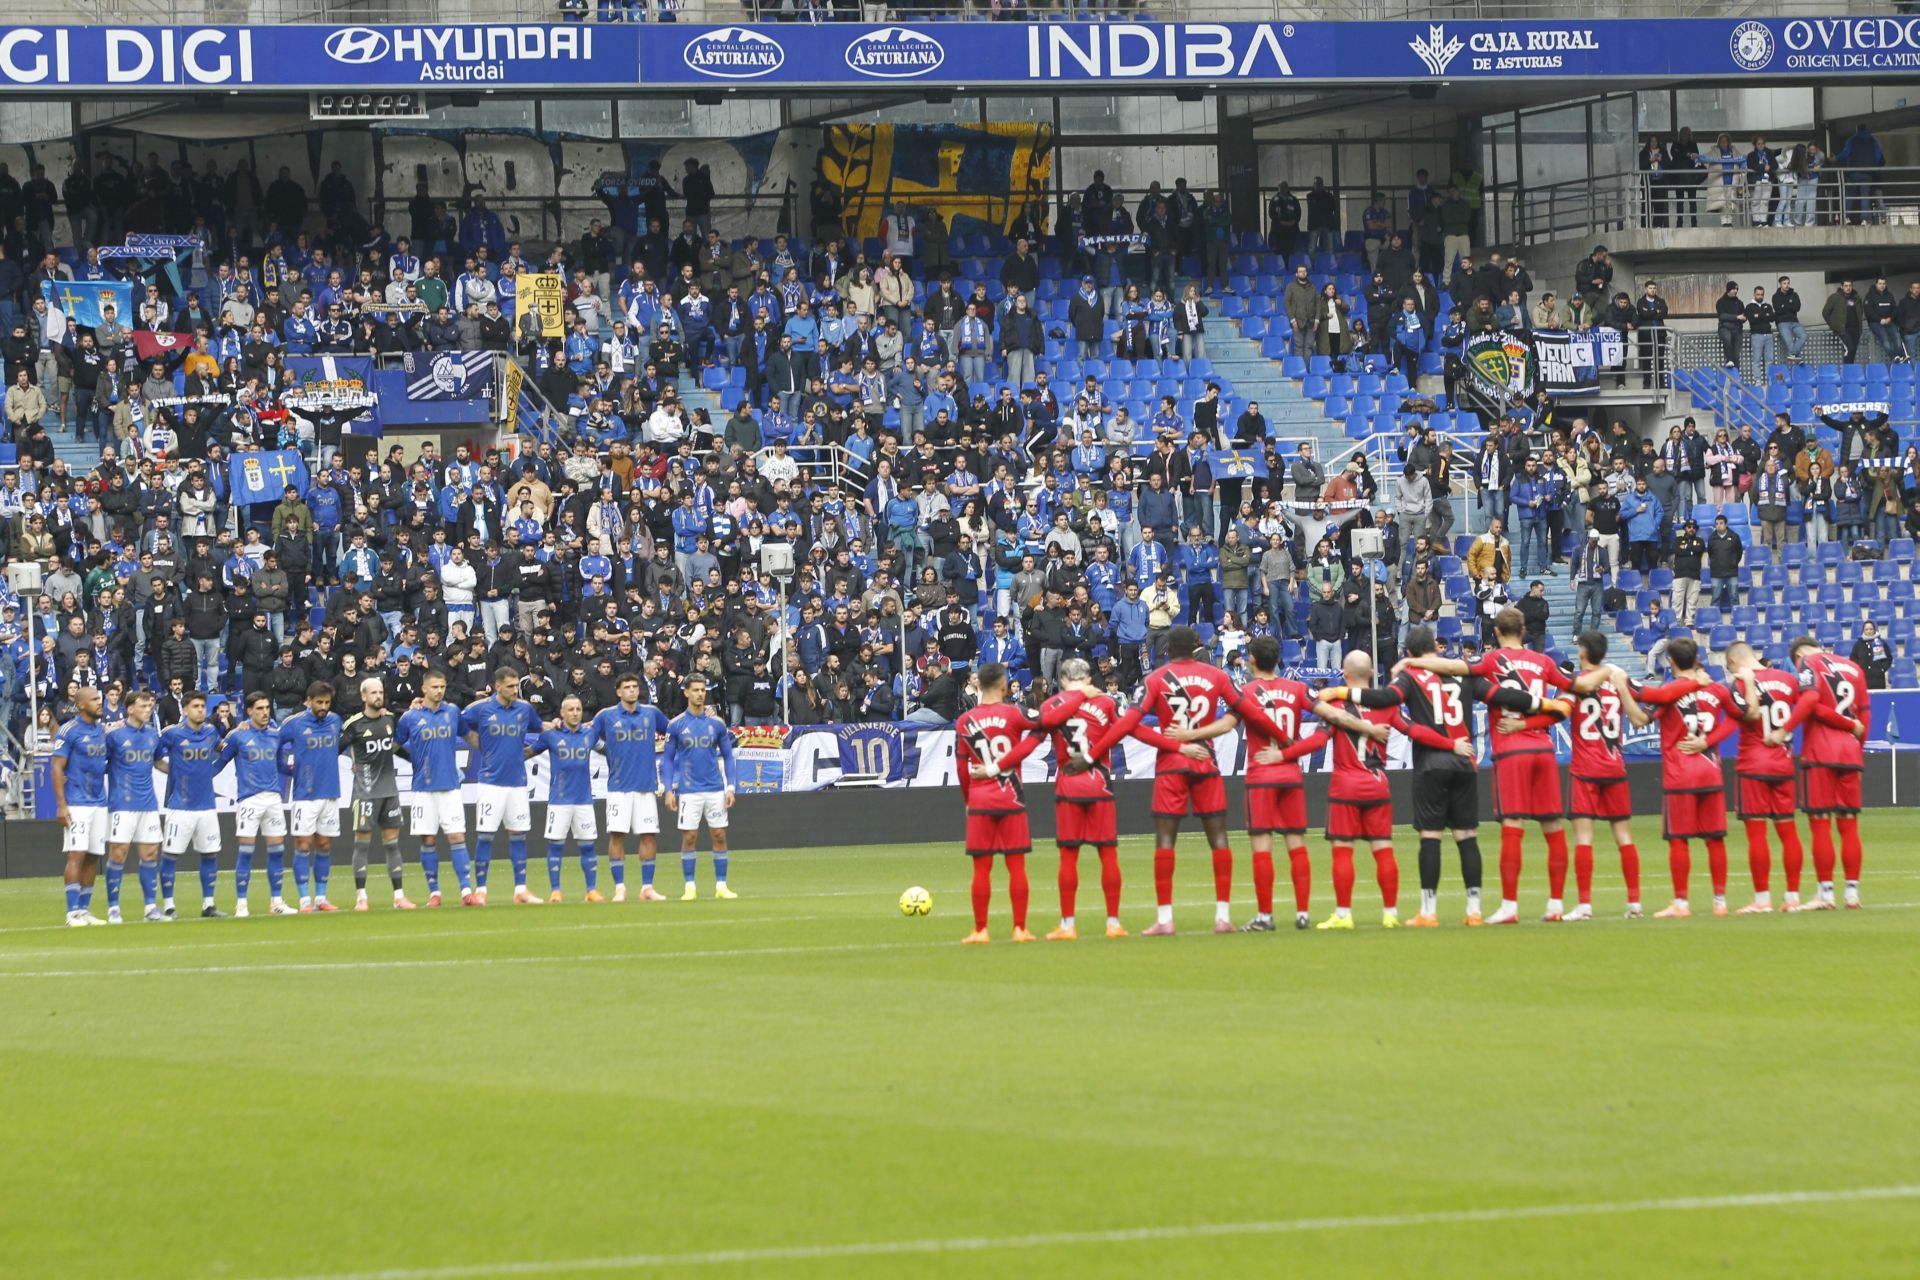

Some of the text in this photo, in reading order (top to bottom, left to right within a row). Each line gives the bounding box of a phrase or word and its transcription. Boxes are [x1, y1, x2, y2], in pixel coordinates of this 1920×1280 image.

[1735, 23, 1768, 37] OVIEDO
[394, 27, 592, 62] HYUNDAI
[1470, 30, 1599, 53] CAJA RURAL
[106, 29, 253, 83] DIGI
[692, 45, 777, 66] ASTURIANA
[853, 46, 937, 66] ASTURIANA
[1473, 55, 1562, 70] DE ASTURIAS
[1786, 54, 1840, 69] ORIGEN
[1843, 54, 1870, 68] DEL
[420, 61, 504, 81] Asturdai
[628, 177, 657, 187] OVIEDO
[1179, 675, 1215, 692] MENDY
[1426, 682, 1464, 727] 13
[1834, 680, 1856, 715] 2
[1168, 695, 1211, 732] 32
[1579, 695, 1622, 741] 23
[421, 725, 453, 741] DIGI
[488, 722, 521, 737] DIGI
[615, 728, 648, 742] DIGI
[838, 721, 901, 742] VILLAVERDE
[306, 735, 338, 749] DIGI
[682, 735, 715, 749] DIGI
[1066, 718, 1091, 758] 3
[850, 736, 891, 780] 10
[239, 806, 255, 821] 22
[294, 808, 302, 821] 4
[359, 801, 374, 817] 13
[479, 803, 493, 816] 12
[681, 800, 687, 815] 7
[71, 821, 86, 834] 23
[113, 813, 121, 827] 9
[168, 822, 179, 837] 11
